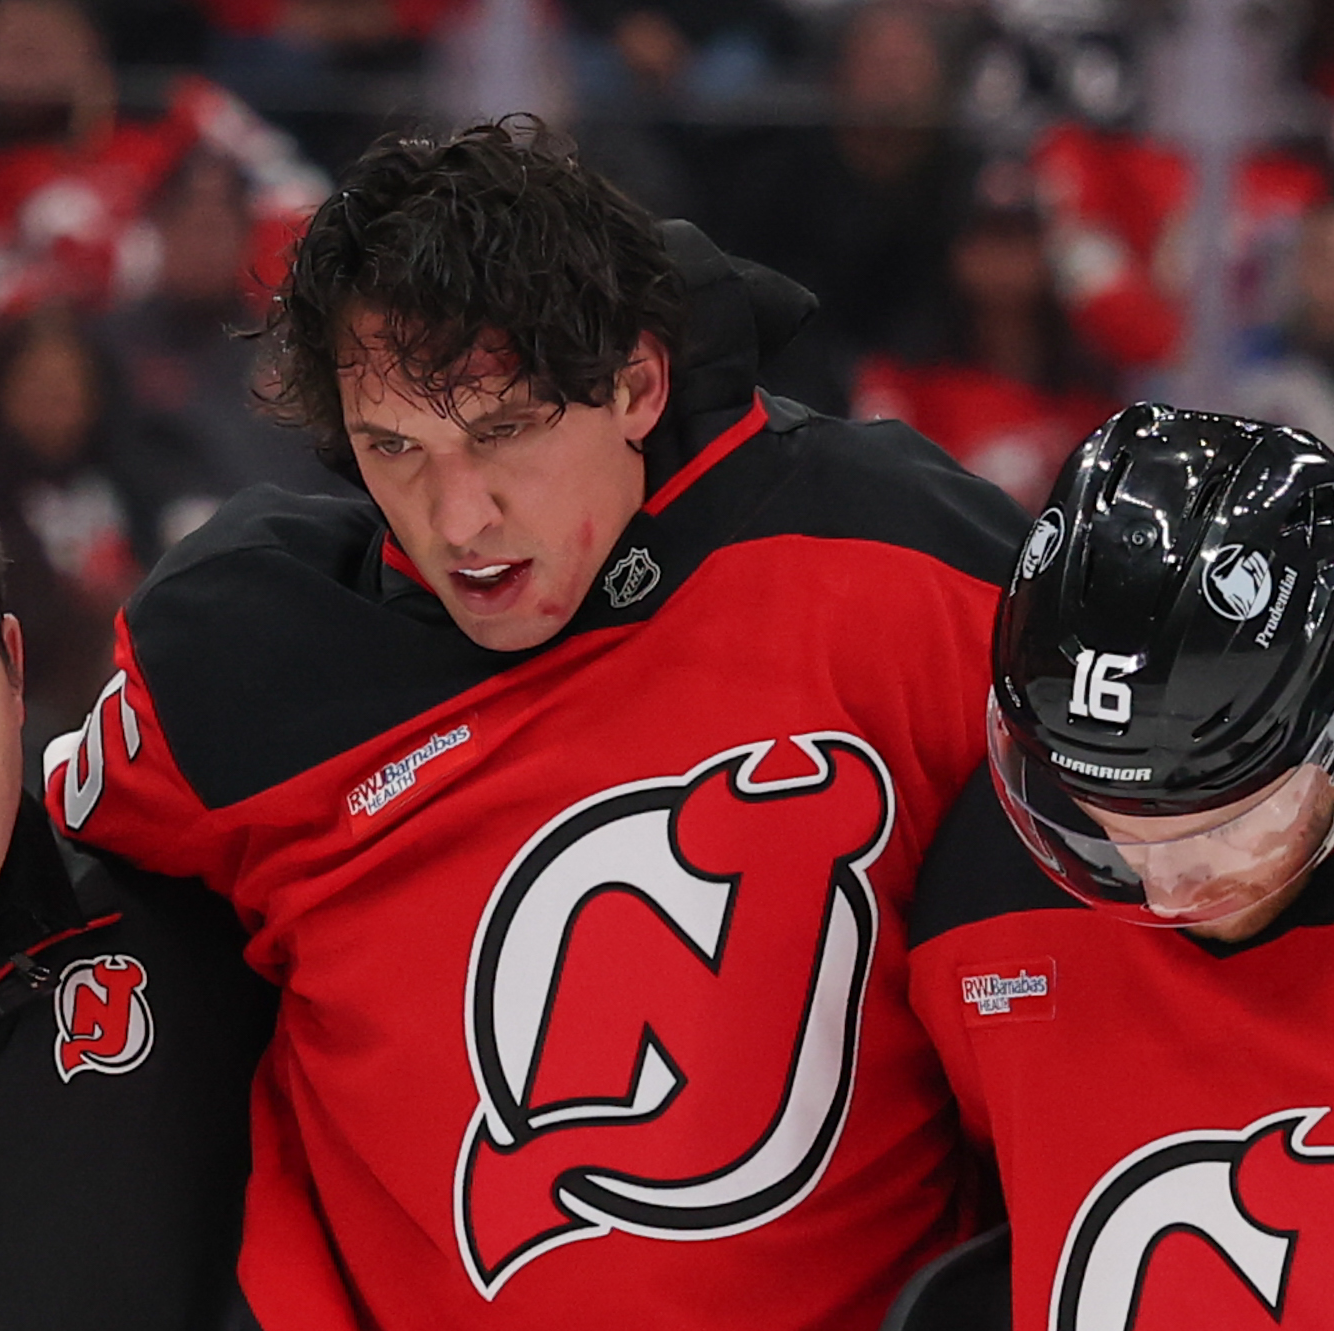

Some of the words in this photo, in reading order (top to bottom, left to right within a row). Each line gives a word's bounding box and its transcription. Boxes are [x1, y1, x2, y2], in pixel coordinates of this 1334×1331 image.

[1254, 565, 1299, 650] Prudential
[1069, 648, 1135, 724] 16
[367, 771, 414, 812] HEALTH
[1050, 750, 1152, 783] WARRIOR
